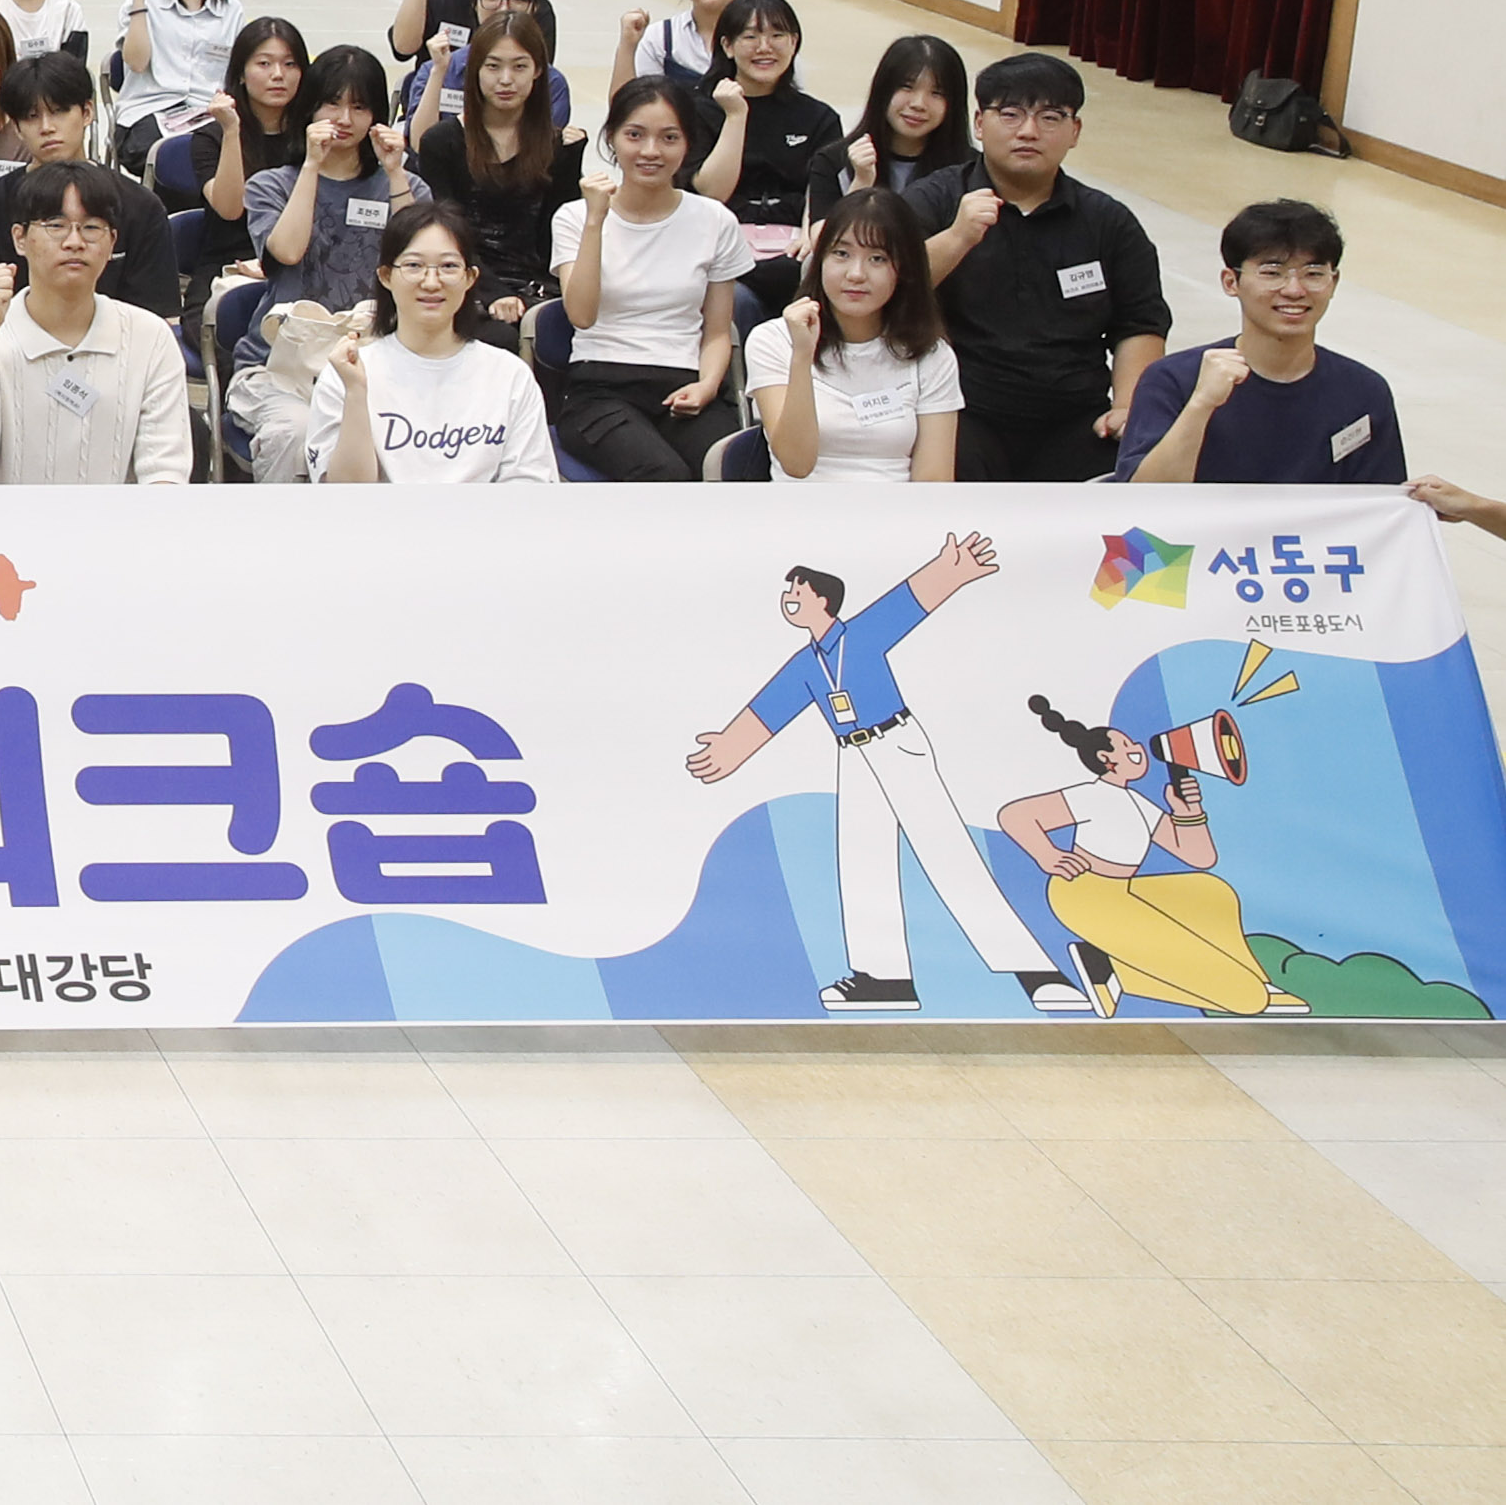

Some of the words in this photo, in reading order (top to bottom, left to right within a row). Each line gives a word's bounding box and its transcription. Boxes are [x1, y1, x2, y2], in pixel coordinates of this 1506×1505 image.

[377, 412, 506, 460] Dodgers
[1208, 535, 1364, 603] 성동구
[1245, 614, 1363, 634] 스마트포용도시
